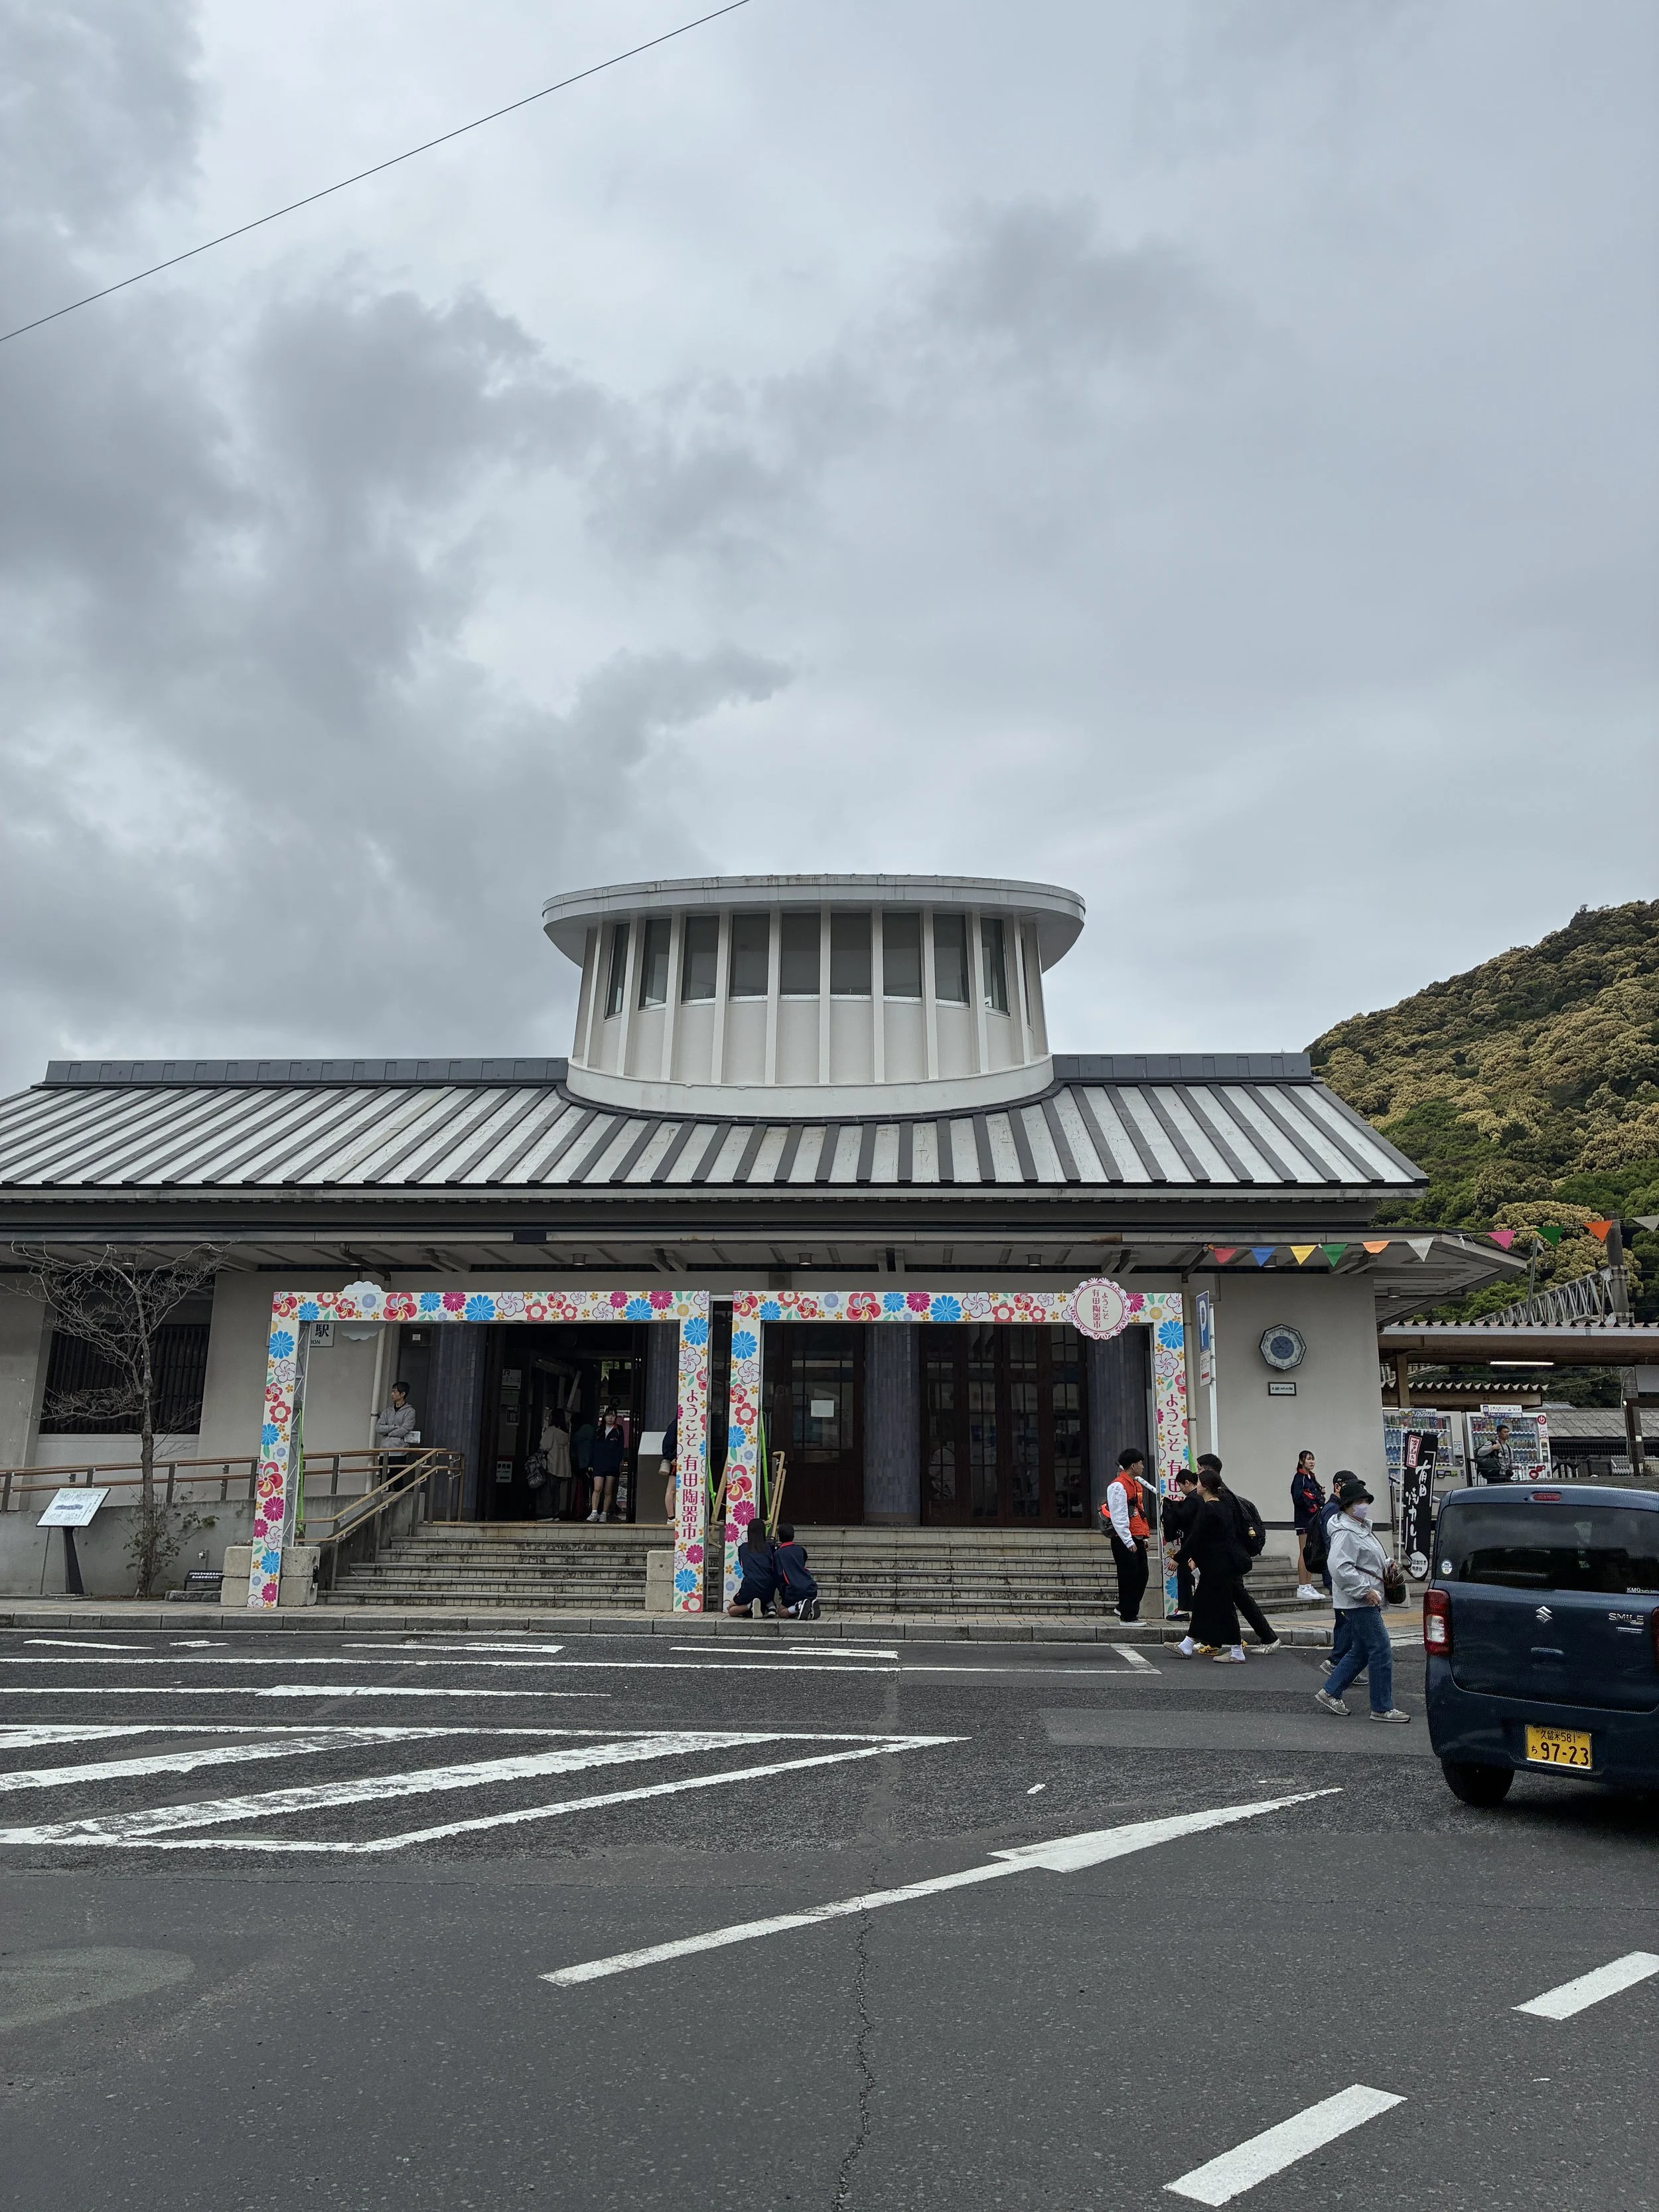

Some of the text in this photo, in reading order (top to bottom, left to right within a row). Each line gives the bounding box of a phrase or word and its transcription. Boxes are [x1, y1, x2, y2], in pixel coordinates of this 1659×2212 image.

[1092, 1289, 1101, 1328] 有田陶器市
[1199, 1300, 1207, 1347] P
[315, 1324, 329, 1337] 駅
[1166, 1394, 1181, 1452] ようこそ
[682, 1390, 698, 1540] ようこそ 有田陶器市
[1415, 1459, 1431, 1497] 有田
[1609, 1613, 1644, 1625] SMILE
[1540, 1741, 1589, 1766] 97-23
